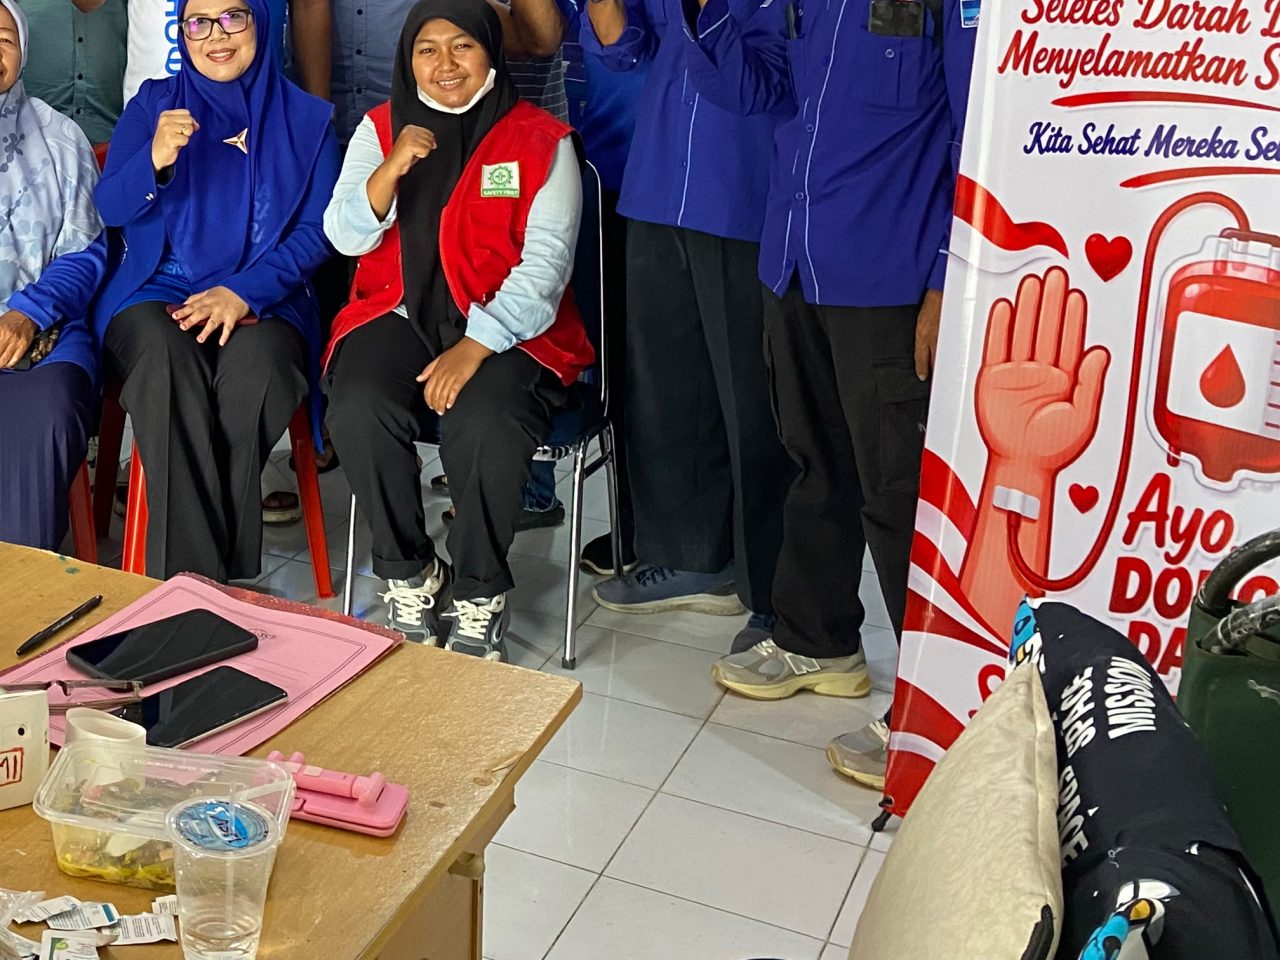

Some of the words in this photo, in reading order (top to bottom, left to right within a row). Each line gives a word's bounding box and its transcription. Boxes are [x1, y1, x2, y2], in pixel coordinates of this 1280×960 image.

[998, 30, 1248, 90] Menyelamatkan
[1023, 121, 1074, 156] Kita
[1077, 122, 1141, 157] Sehat
[1144, 125, 1240, 161] Mereka
[1108, 656, 1157, 740] MISSION
